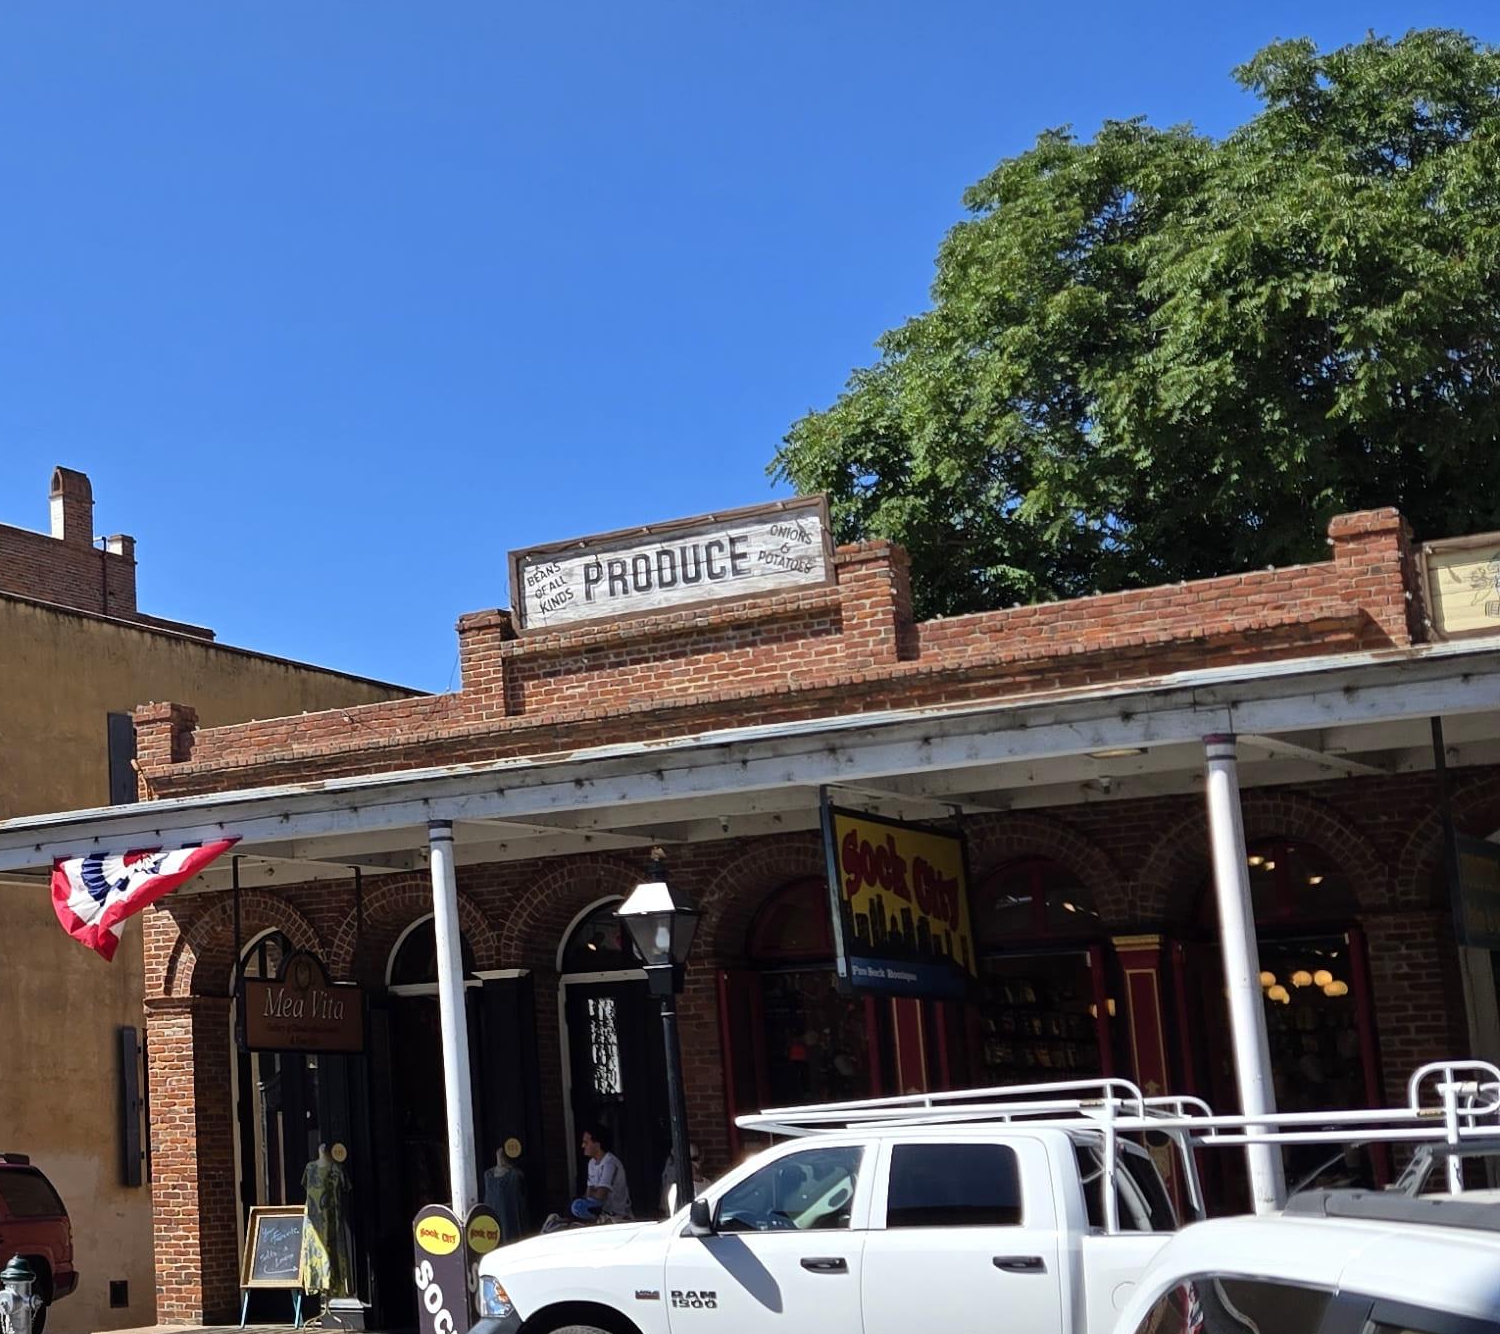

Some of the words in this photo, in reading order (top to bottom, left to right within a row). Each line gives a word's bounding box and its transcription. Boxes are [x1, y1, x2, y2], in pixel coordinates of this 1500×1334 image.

[780, 542, 790, 554] &
[526, 562, 562, 588] BEANS
[583, 535, 749, 602] PRODUCE
[758, 550, 814, 575] POTATOES
[534, 587, 548, 600] OF
[549, 575, 568, 591] ALL
[539, 588, 575, 615] KINDS
[263, 987, 304, 1019] Mea
[312, 990, 345, 1020] Vita
[670, 1290, 717, 1300] RAM
[671, 1298, 718, 1308] 1500
